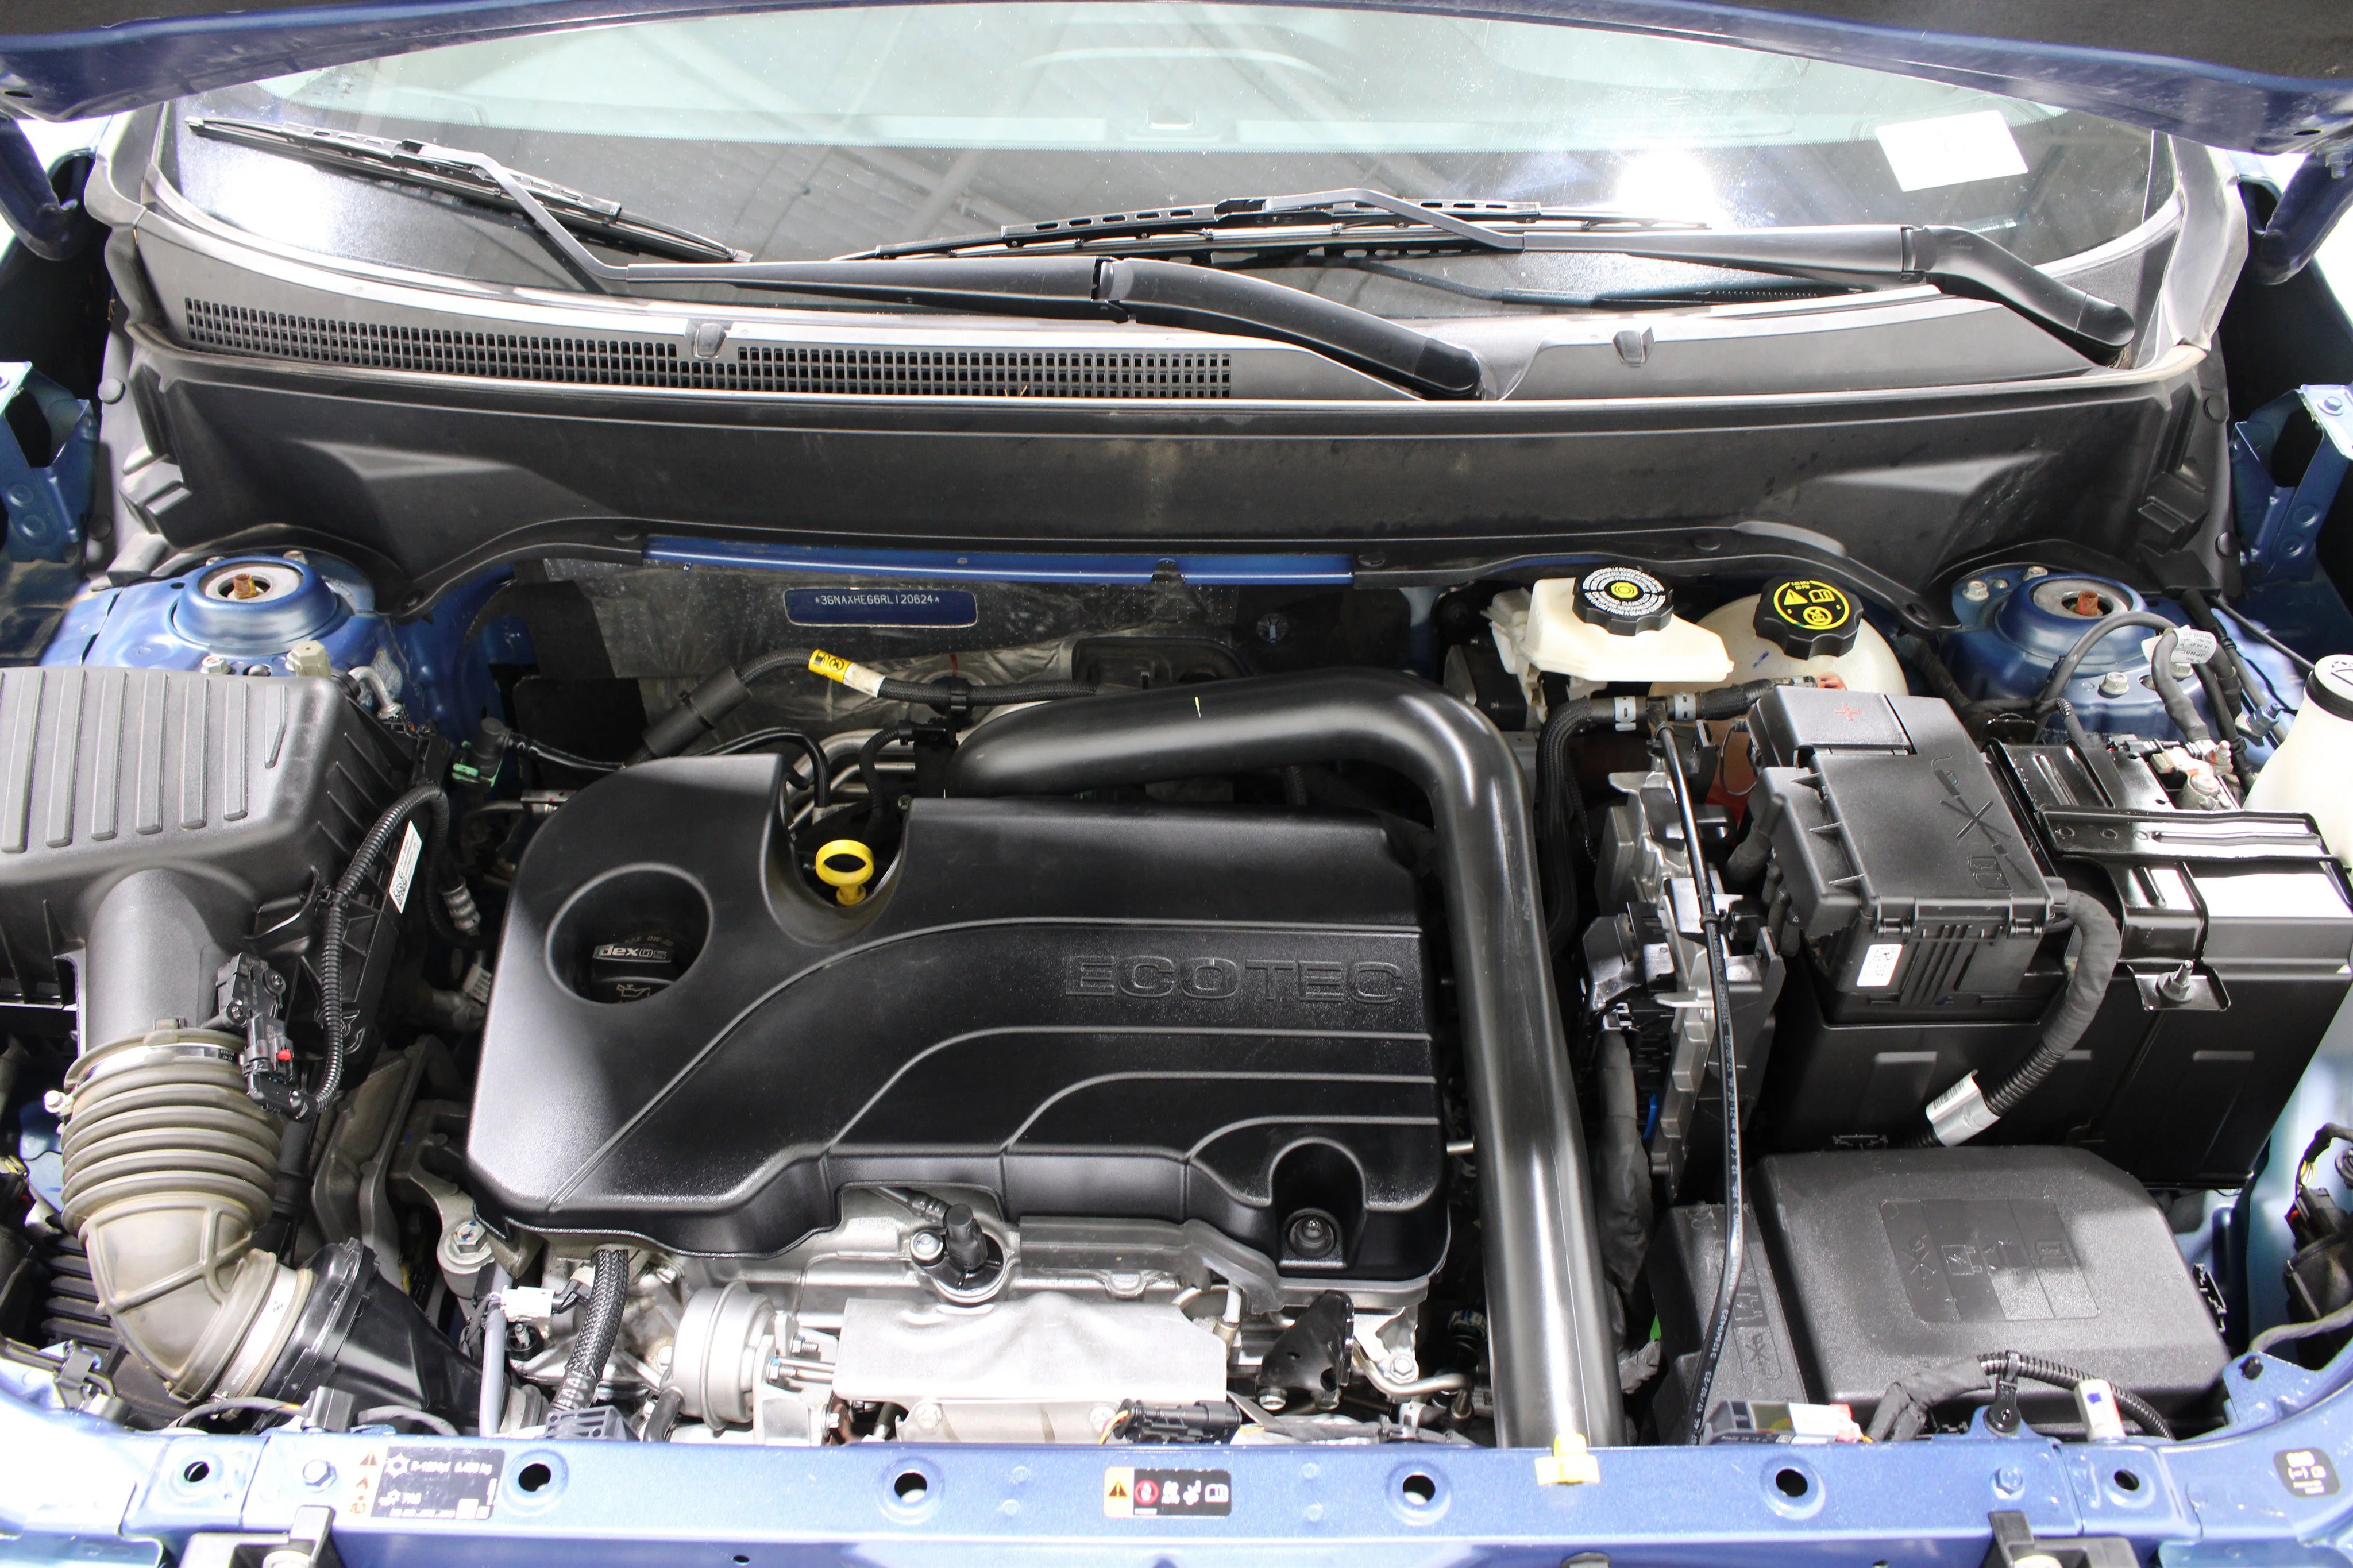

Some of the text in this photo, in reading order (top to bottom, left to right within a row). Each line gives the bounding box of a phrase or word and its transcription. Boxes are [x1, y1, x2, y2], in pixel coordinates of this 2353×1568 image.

[599, 944, 668, 959] dexos
[1066, 955, 1403, 1004] ECOTEC
[1697, 1371, 1712, 1413] 17/02/23
[1710, 1308, 1729, 1360] 312049423
